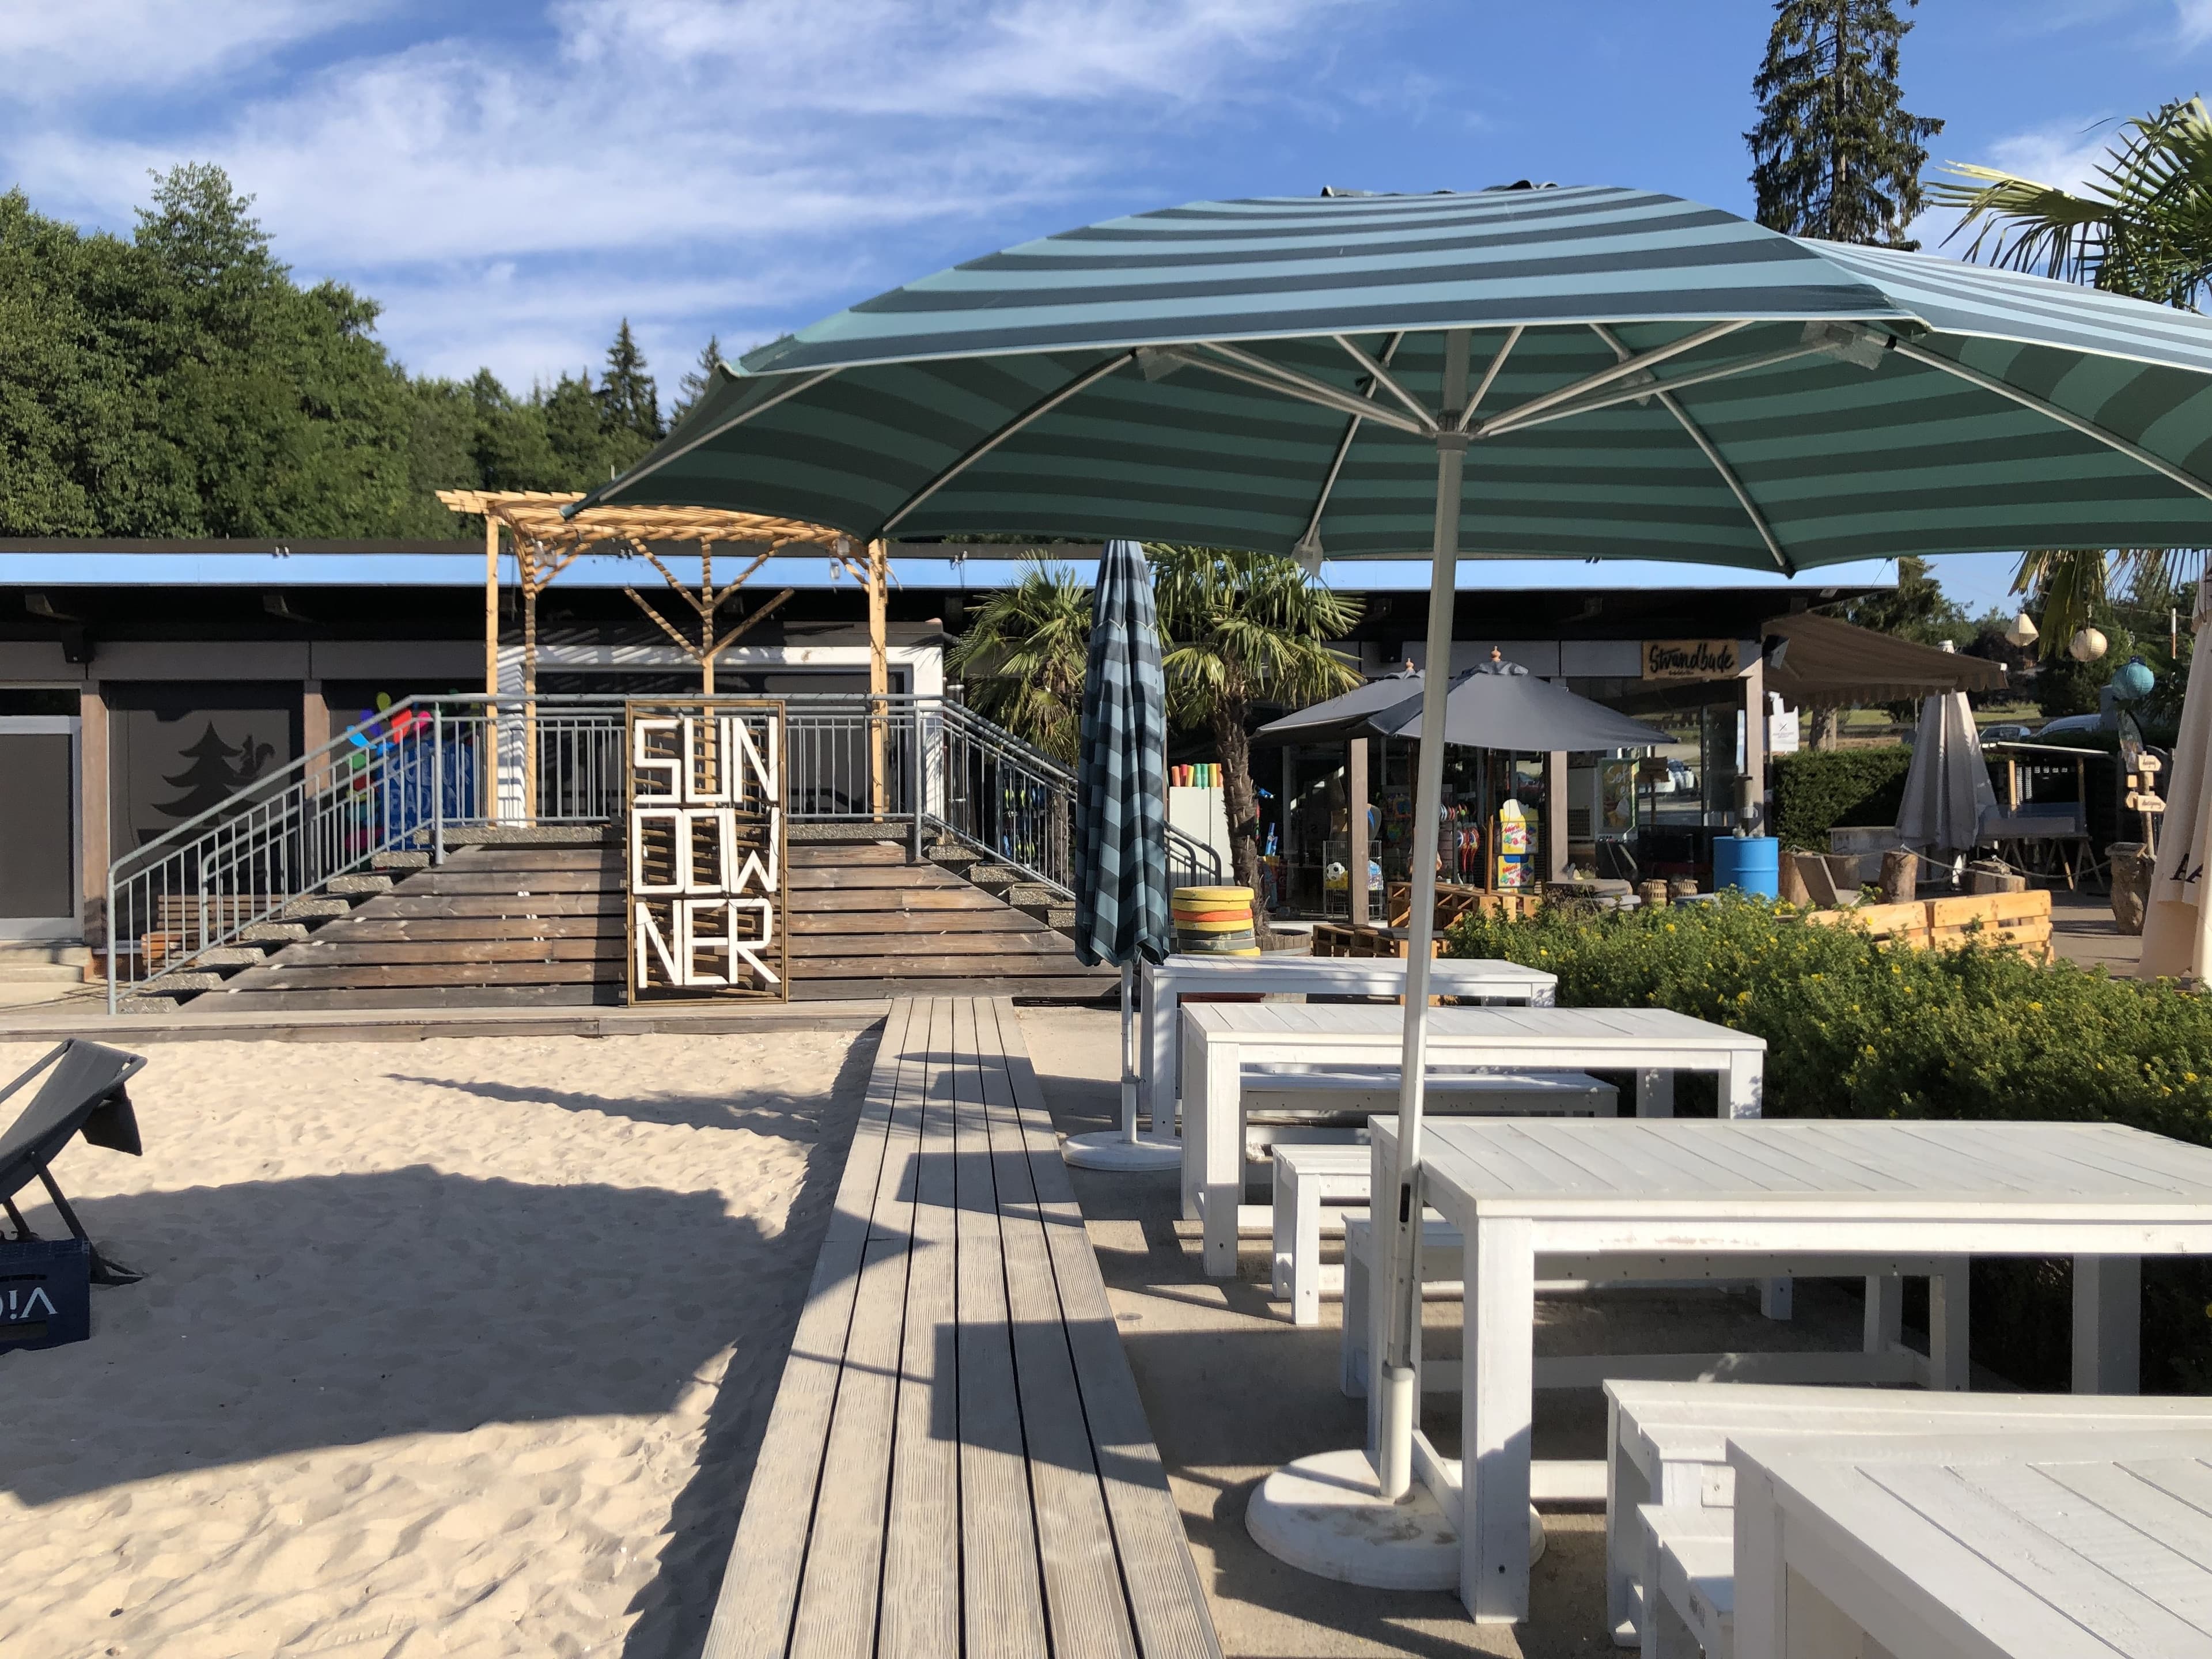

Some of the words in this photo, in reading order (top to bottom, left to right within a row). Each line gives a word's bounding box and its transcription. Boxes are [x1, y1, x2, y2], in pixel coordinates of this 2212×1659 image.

[1649, 642, 1734, 673] Strandbude
[634, 716, 778, 804] SUN
[631, 806, 779, 895] DOW
[635, 898, 781, 989] NER
[0, 1287, 58, 1320] Vi
